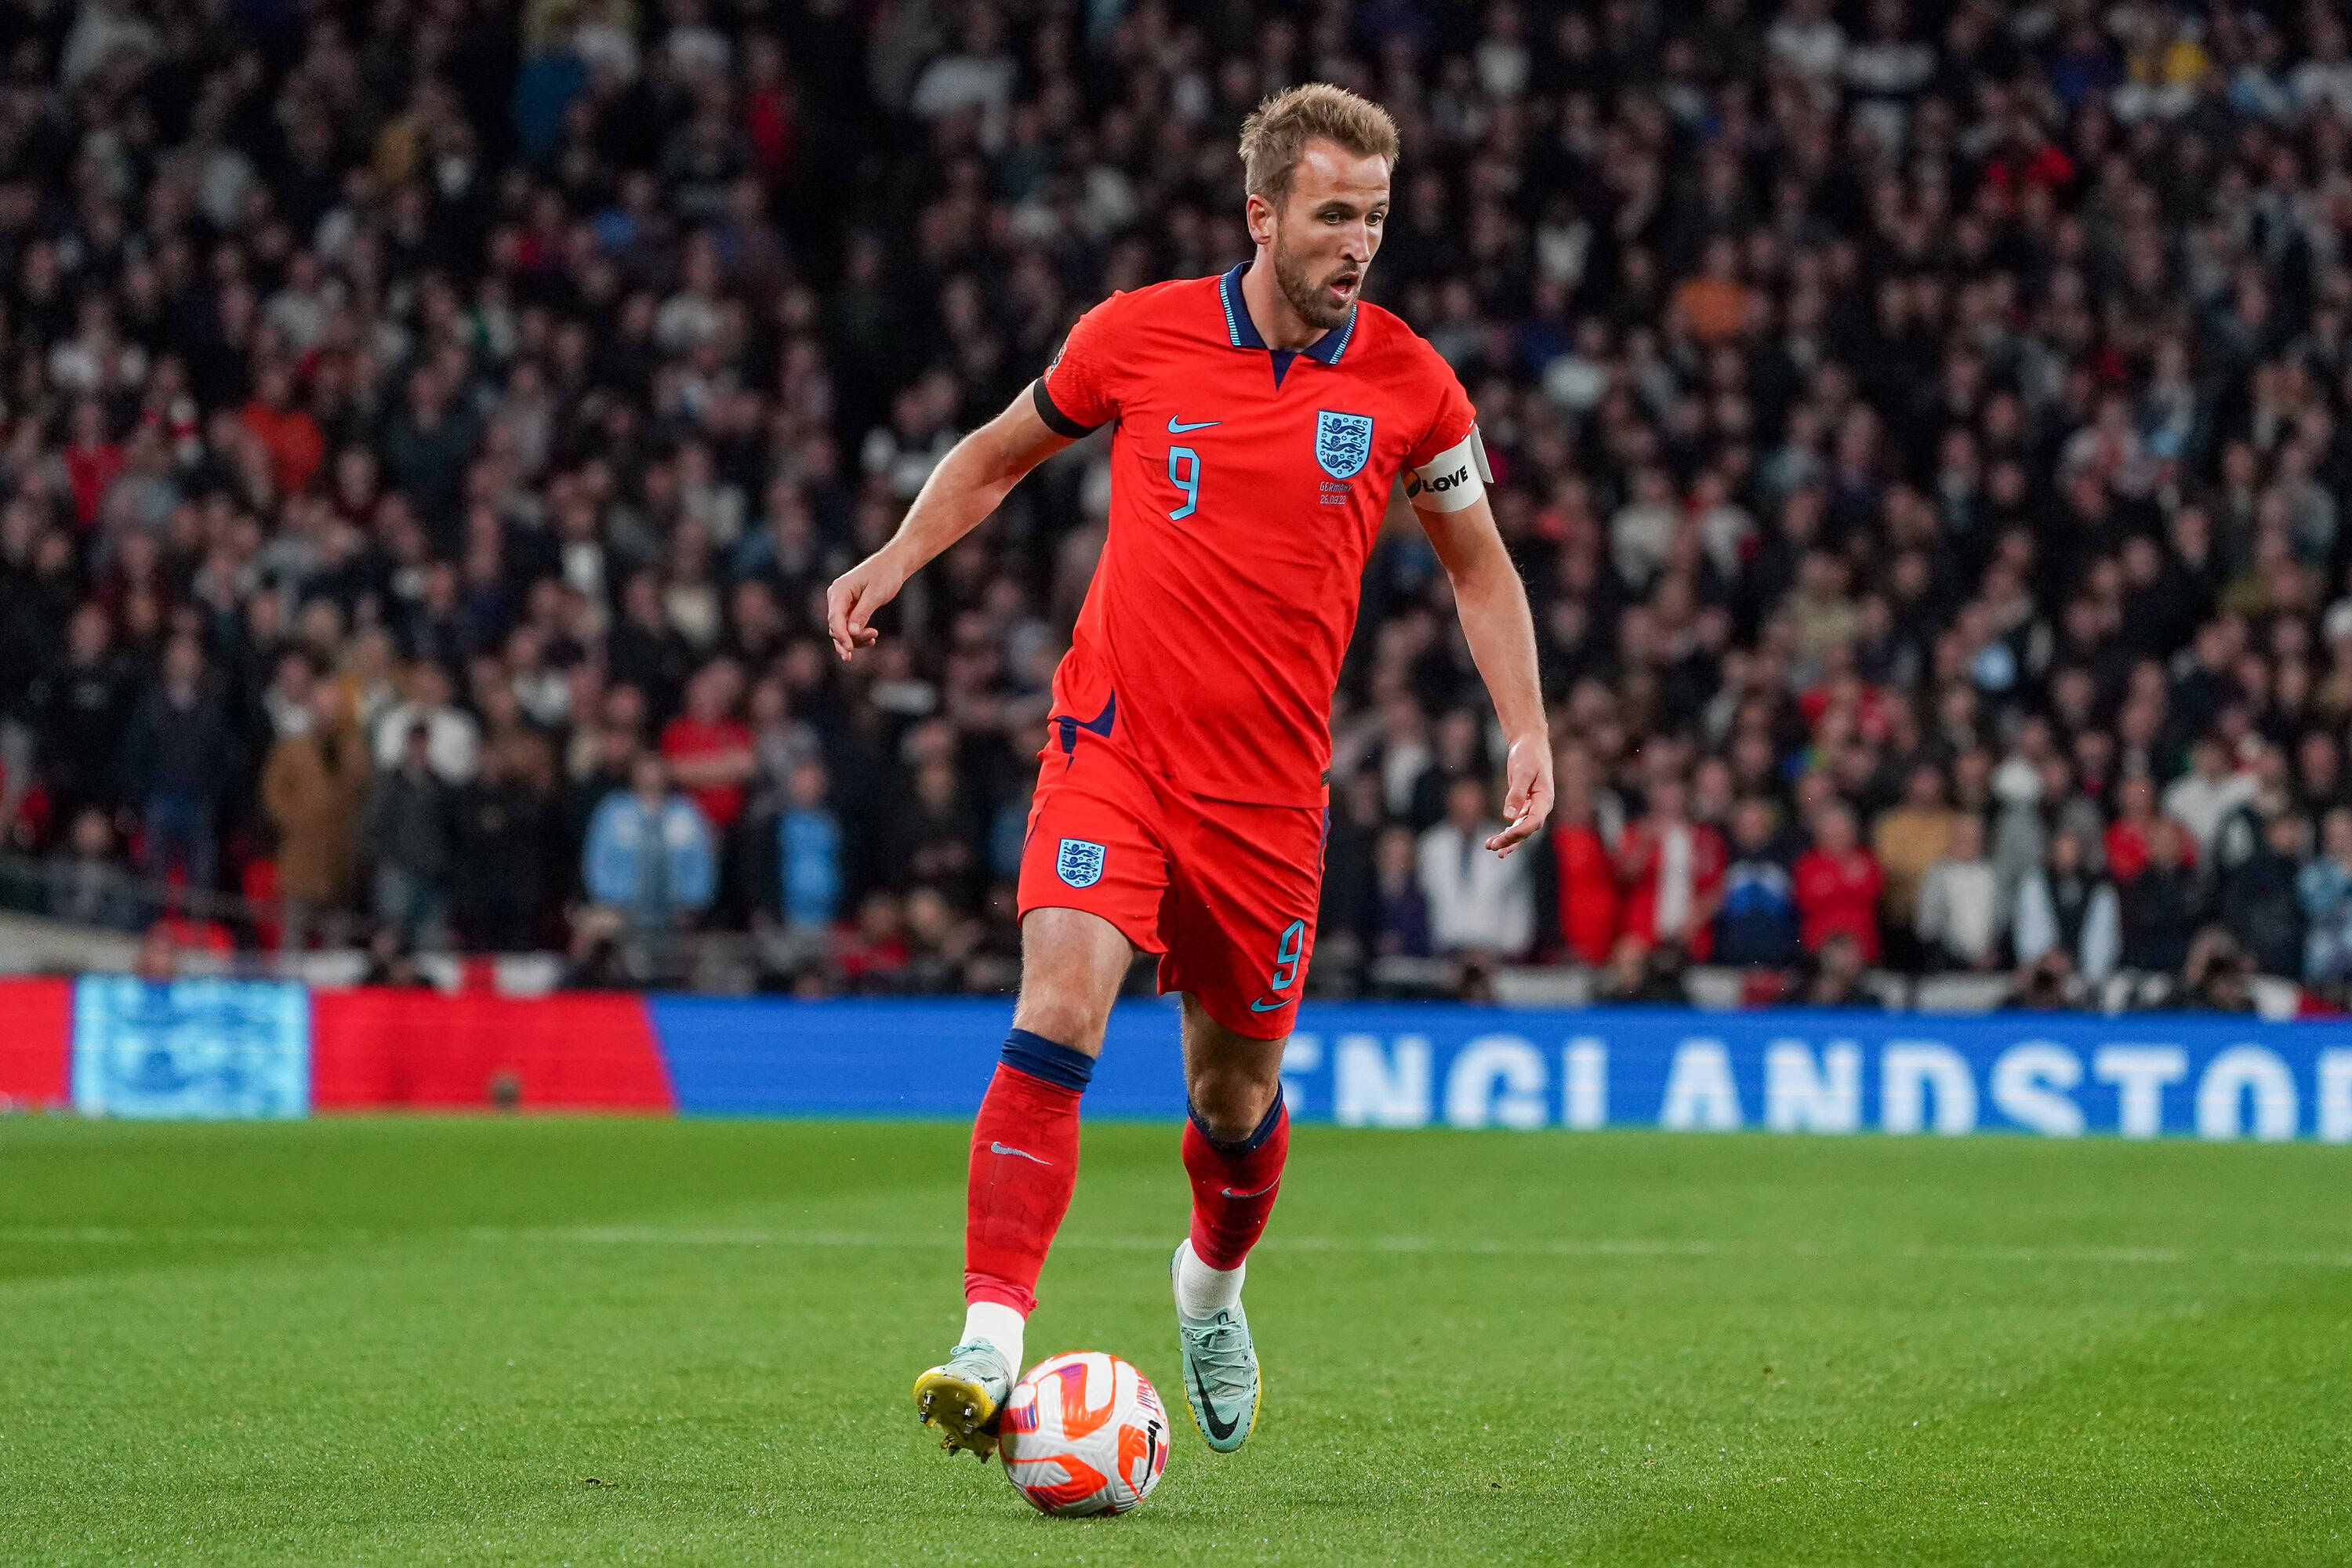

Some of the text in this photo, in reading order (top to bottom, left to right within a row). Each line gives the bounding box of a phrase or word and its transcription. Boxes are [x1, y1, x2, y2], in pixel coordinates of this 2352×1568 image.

[1168, 445, 1201, 521] 9
[1319, 481, 1353, 492] GERMANY
[1421, 465, 1468, 492] LOVE
[1272, 919, 1305, 991] 9
